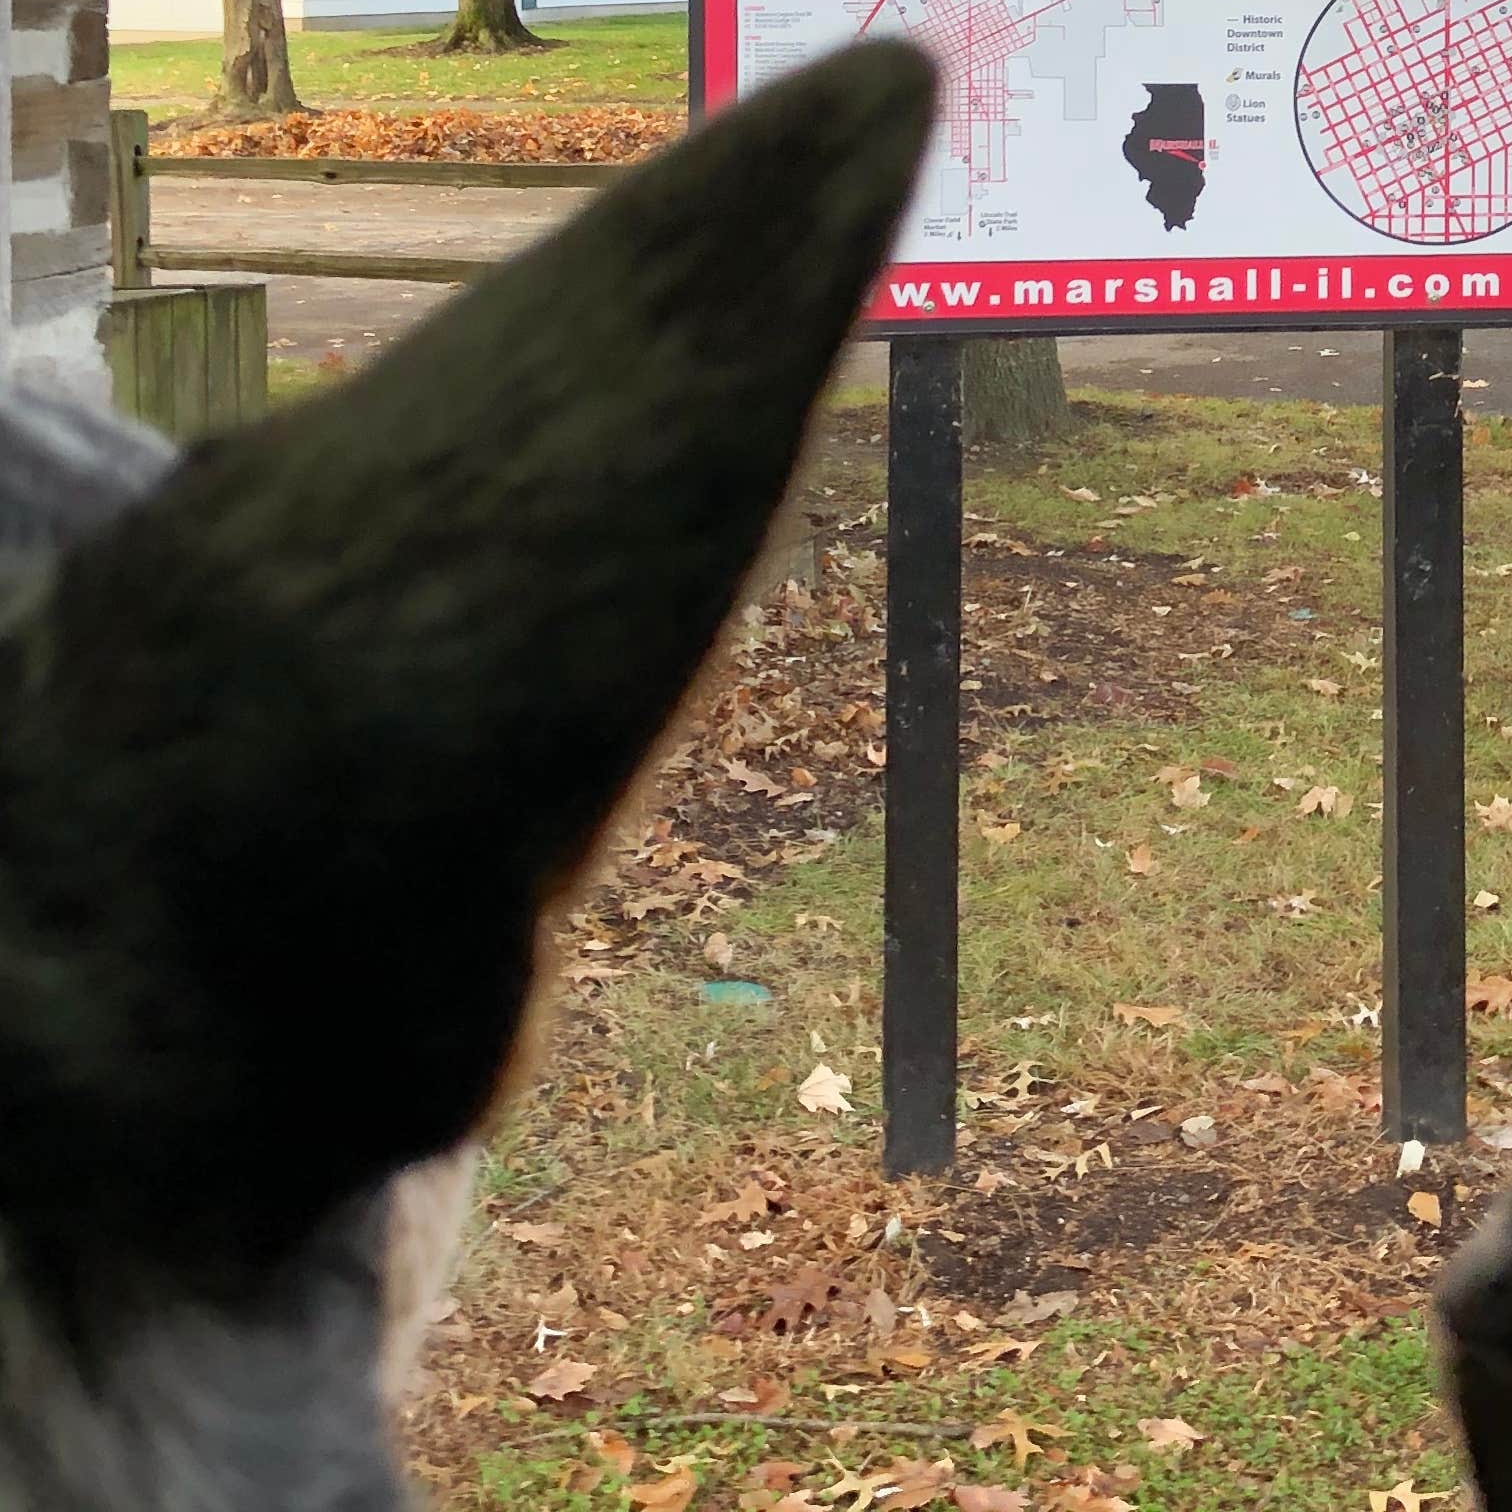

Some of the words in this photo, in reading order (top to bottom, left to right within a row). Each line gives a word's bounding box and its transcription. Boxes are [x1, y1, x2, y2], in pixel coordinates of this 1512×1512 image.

[1243, 14, 1283, 24] Historic
[1227, 29, 1283, 38] Downtown
[1227, 42, 1265, 52] District
[1245, 70, 1281, 80] Murals
[1243, 98, 1266, 108] Lion
[1226, 113, 1265, 123] Statues
[889, 265, 1501, 307] ww.marshall-il.com
